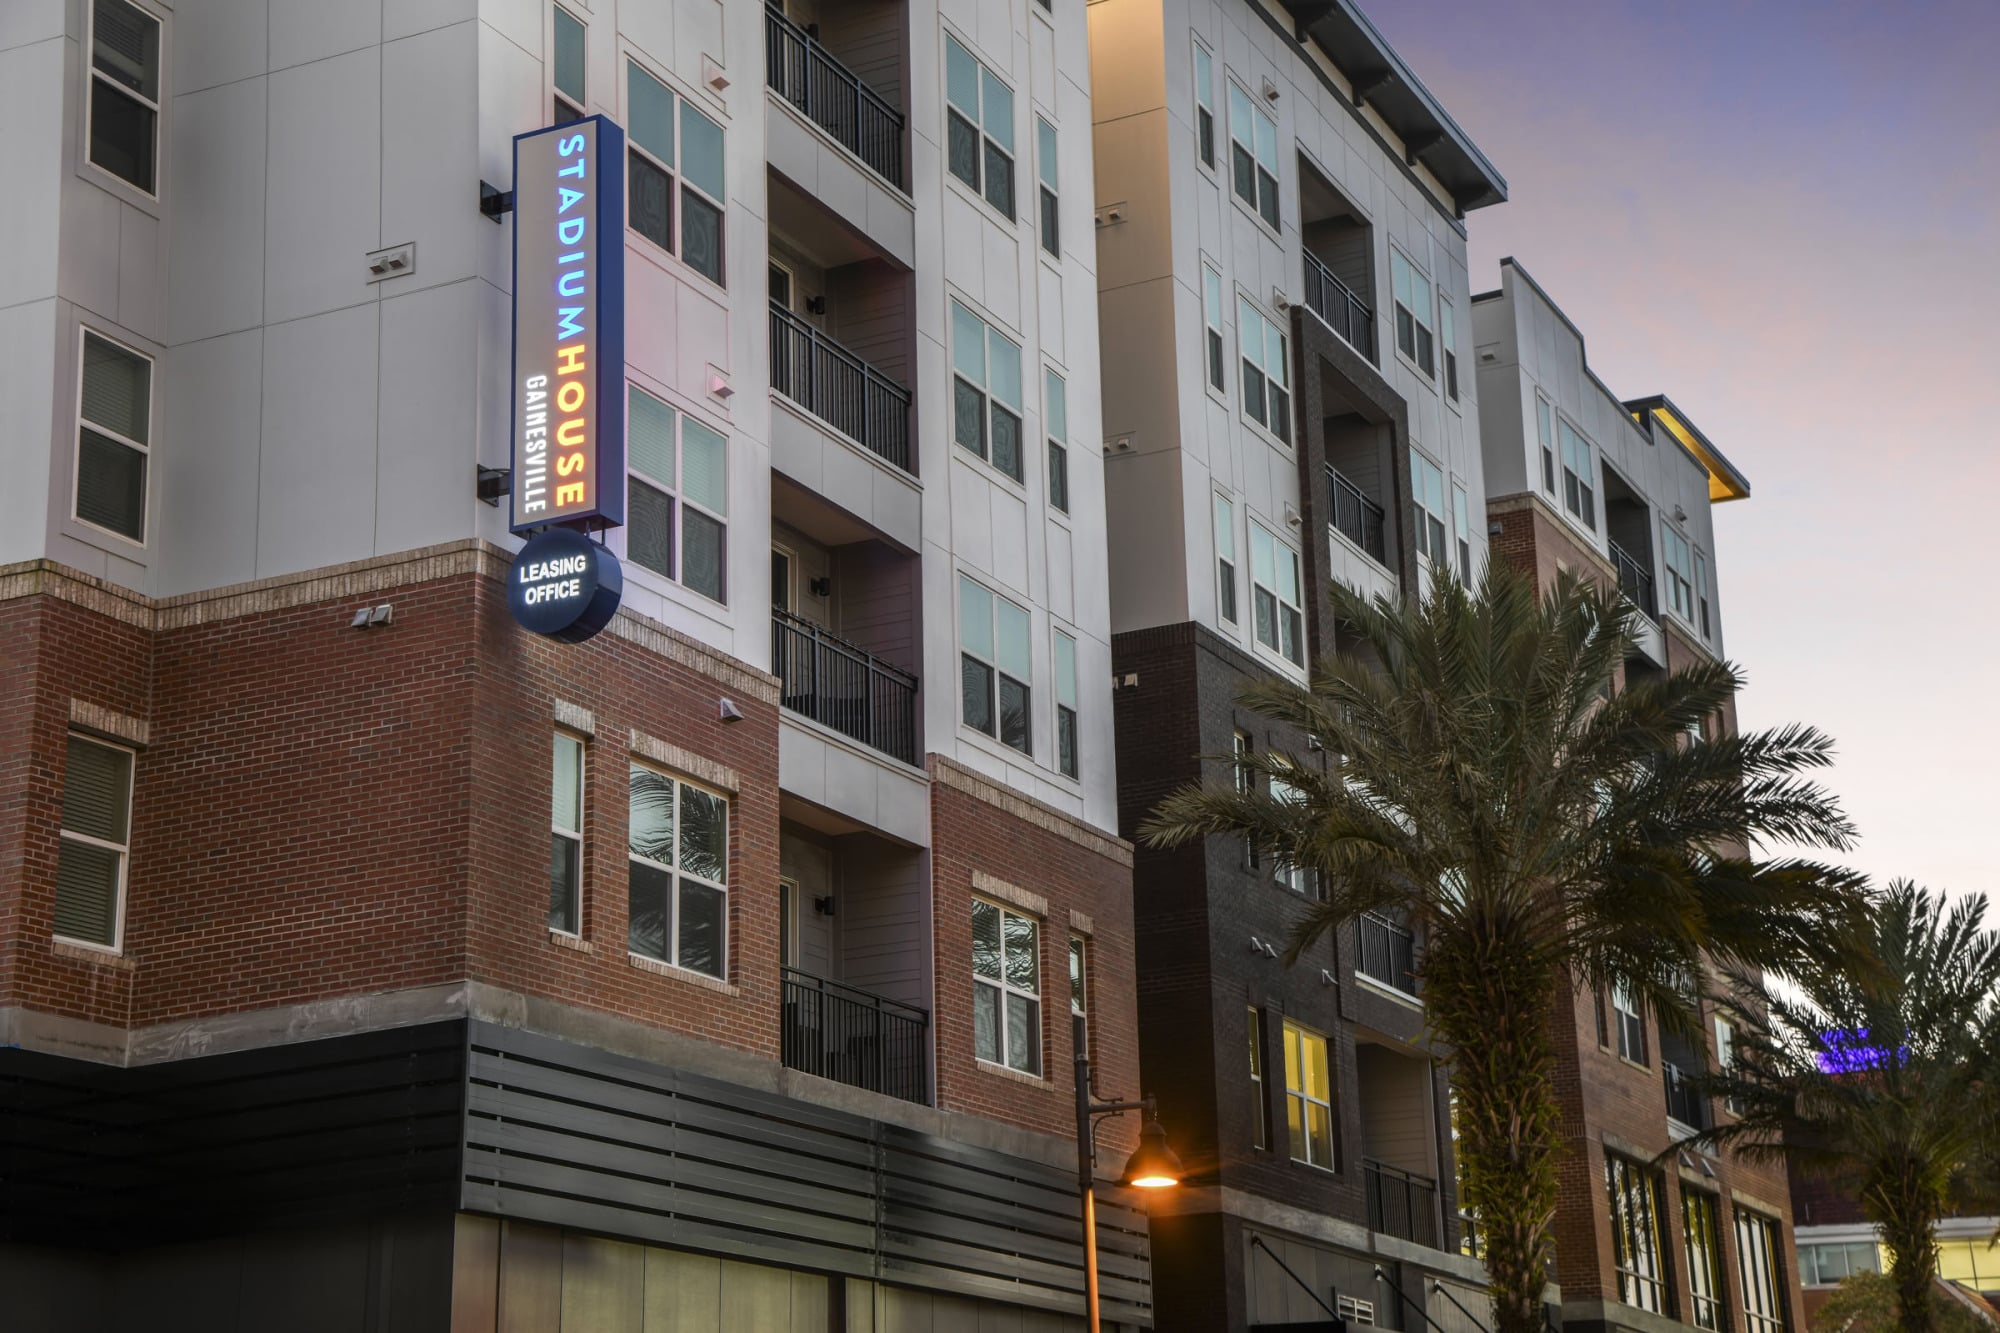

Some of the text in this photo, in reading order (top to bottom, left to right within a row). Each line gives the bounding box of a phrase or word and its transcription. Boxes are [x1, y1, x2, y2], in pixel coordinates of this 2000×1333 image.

[525, 375, 547, 513] GAINESVILLE
[520, 555, 586, 583] LEASING
[525, 579, 580, 605] OFFICE
